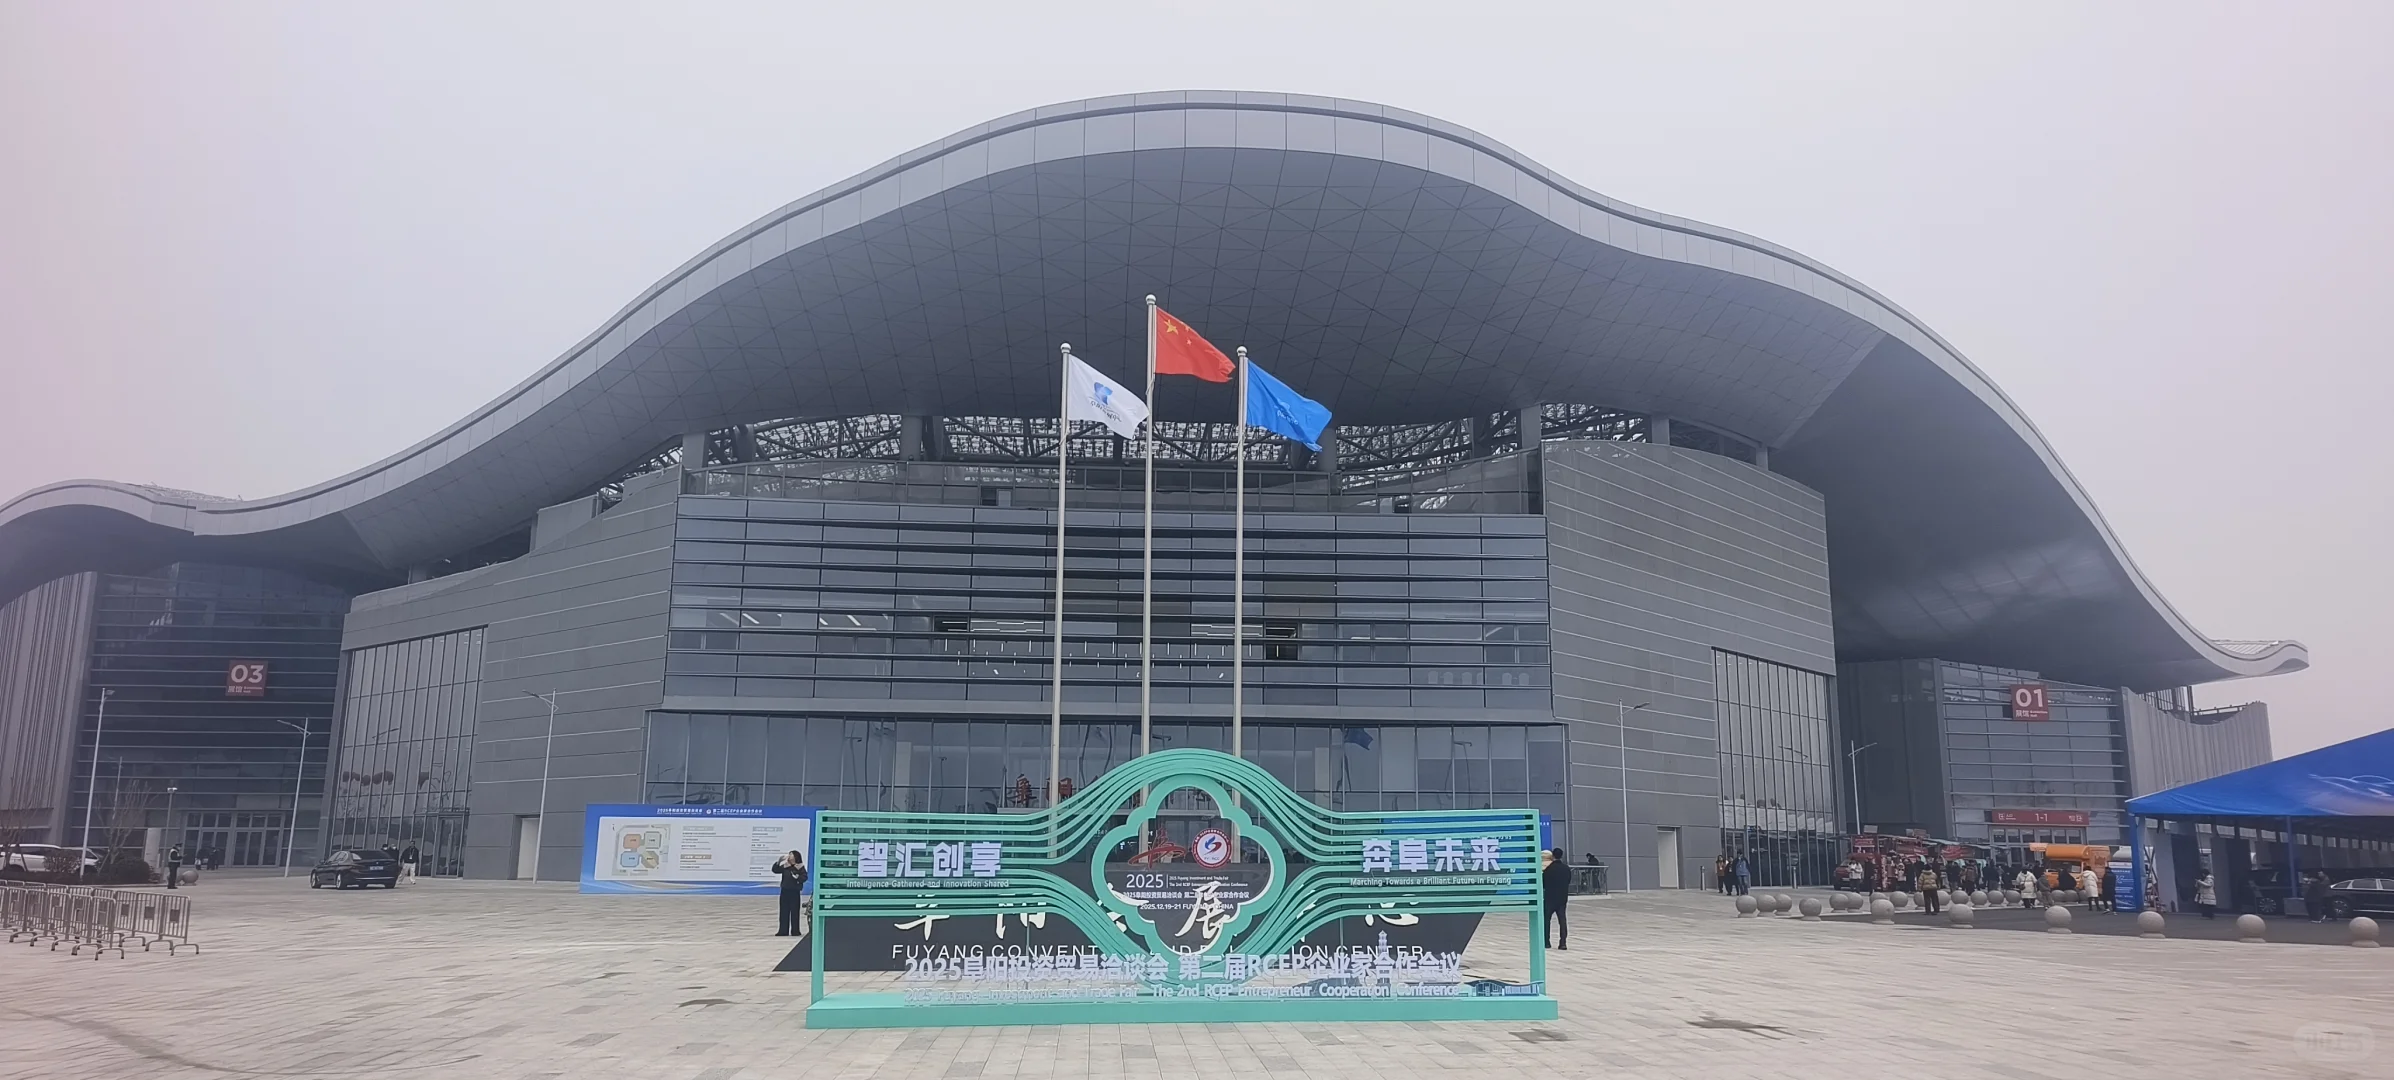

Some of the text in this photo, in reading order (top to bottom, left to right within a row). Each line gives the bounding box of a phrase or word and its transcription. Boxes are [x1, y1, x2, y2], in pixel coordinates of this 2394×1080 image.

[231, 664, 264, 683] 03
[2015, 688, 2043, 707] 01
[2035, 813, 2048, 822] 1-1
[858, 842, 1002, 877] 智汇创享
[1362, 837, 1501, 873] 奔阜未来
[847, 879, 888, 889] Intelligence
[892, 879, 925, 888] Gathered
[984, 879, 1009, 887] Shared
[1126, 873, 1164, 888] 2025
[1350, 877, 1382, 887] Marching
[1386, 877, 1414, 885] Towards
[1423, 877, 1451, 885] Brilliant
[1453, 877, 1475, 885] Future
[1486, 877, 1512, 887] Fuyang
[892, 944, 984, 959] FUYANG
[905, 953, 1169, 982] 2025阜阳投资贸易洽谈会
[1178, 951, 1463, 981] 第二届RCEP企业家合作会议
[1119, 984, 1140, 998] Fair
[1151, 984, 1173, 997] The
[1178, 983, 1200, 997] 2nd
[1205, 984, 1233, 996] RCEP
[1238, 983, 1312, 999] Entrepreneur
[1319, 983, 1389, 998] Cooperation
[1396, 982, 1460, 996] Conference
